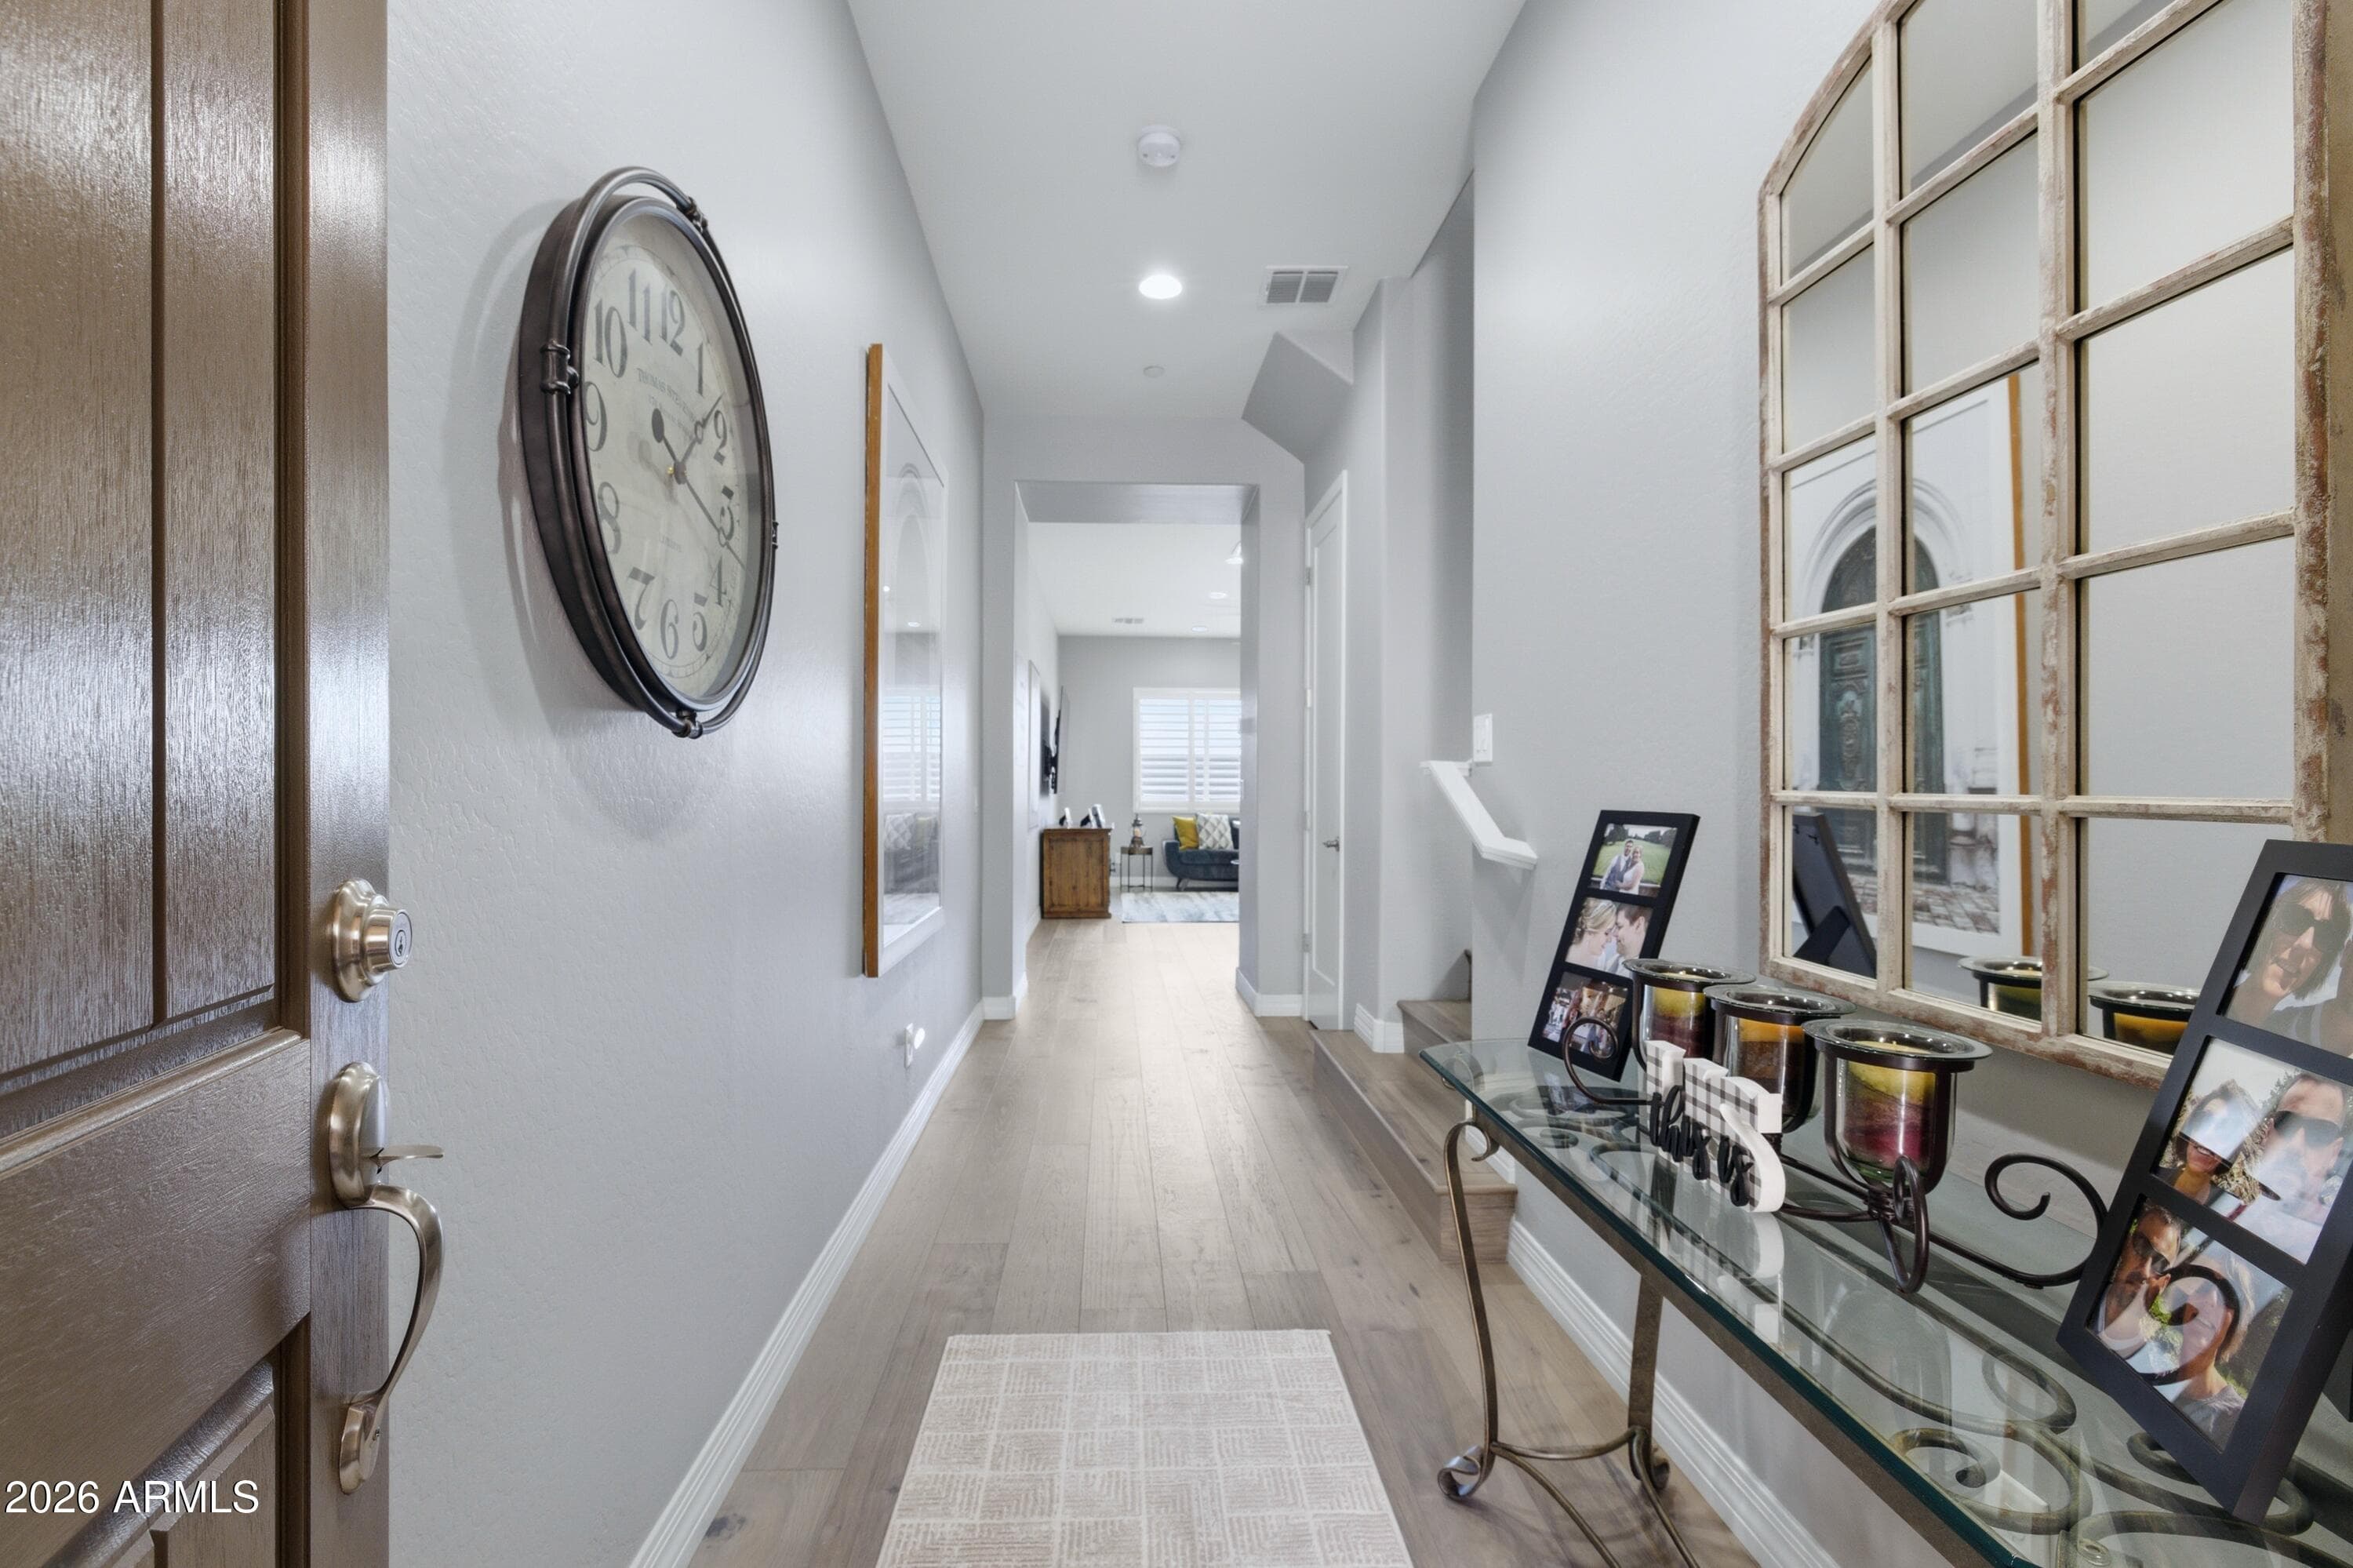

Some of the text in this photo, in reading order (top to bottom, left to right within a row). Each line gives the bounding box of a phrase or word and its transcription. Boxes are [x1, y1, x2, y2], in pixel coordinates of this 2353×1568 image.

[593, 298, 627, 379] 10
[628, 269, 652, 347] 11
[660, 286, 686, 356] 12
[695, 342, 705, 398] 1
[584, 380, 608, 451] 9
[714, 409, 728, 466] 2
[598, 482, 622, 555] 8
[719, 485, 734, 541] 3
[627, 566, 655, 631] 7
[710, 556, 729, 606] 4
[660, 598, 678, 660] 6
[693, 592, 707, 652] 5
